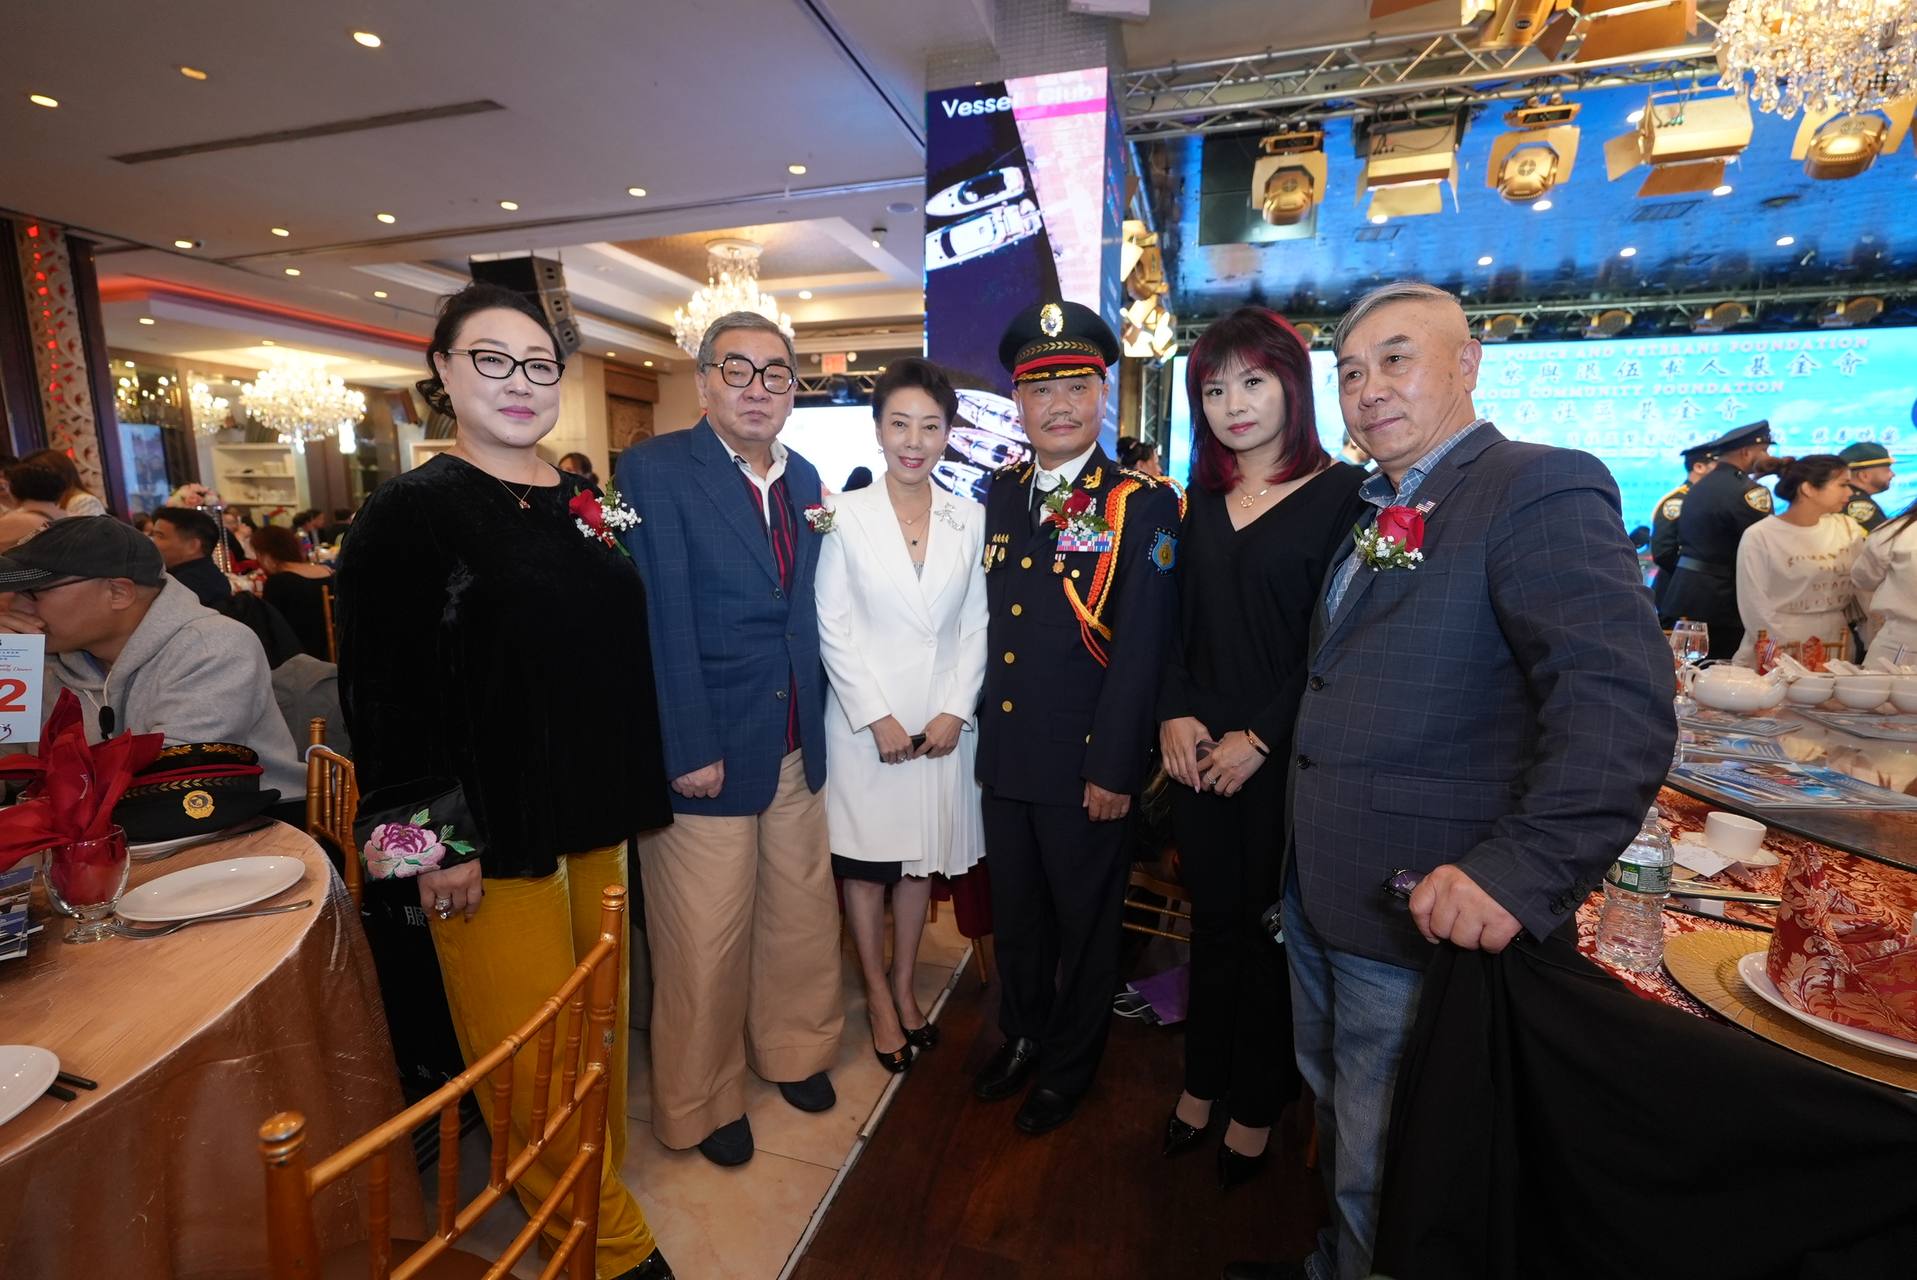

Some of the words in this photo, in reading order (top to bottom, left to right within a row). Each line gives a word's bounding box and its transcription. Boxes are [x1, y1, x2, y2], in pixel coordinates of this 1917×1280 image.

[942, 91, 1025, 118] Vessel
[1037, 83, 1094, 105] Club
[1576, 346, 1614, 358] AND
[1626, 341, 1721, 356] VETERANS
[1730, 336, 1869, 352] FOUNDATION
[1653, 381, 1784, 395] FOUNDATION
